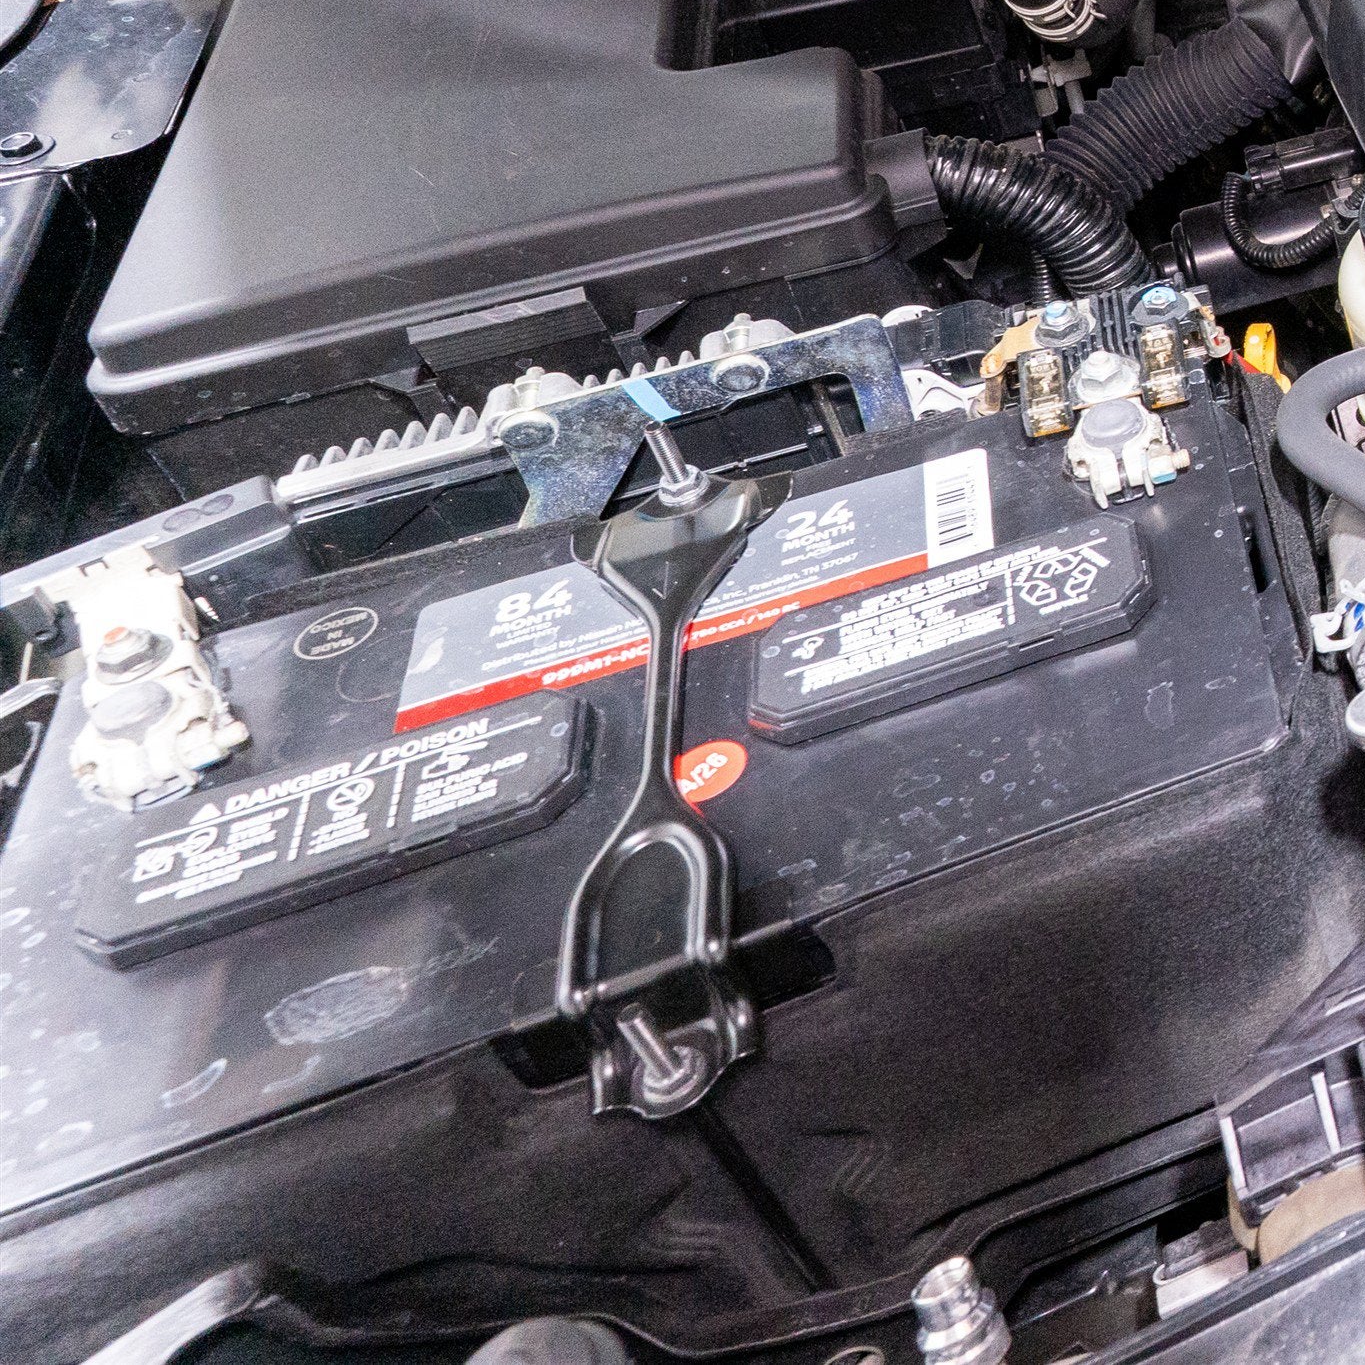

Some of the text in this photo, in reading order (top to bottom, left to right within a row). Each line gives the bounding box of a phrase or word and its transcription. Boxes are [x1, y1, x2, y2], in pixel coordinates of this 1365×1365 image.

[785, 498, 854, 541] 24
[781, 521, 856, 552] MONTH
[781, 537, 857, 566] REPLACEMENT
[801, 564, 820, 577] TN
[821, 552, 860, 571] 37067
[495, 579, 573, 624] 84
[489, 604, 573, 638] MONTH
[496, 625, 562, 649] WARRANTY
[506, 621, 553, 639] LIMITED
[481, 641, 558, 671] Distributed
[558, 636, 577, 648] by
[578, 622, 623, 643] Nissan
[224, 761, 352, 815] DANGER
[379, 717, 491, 766] POISON
